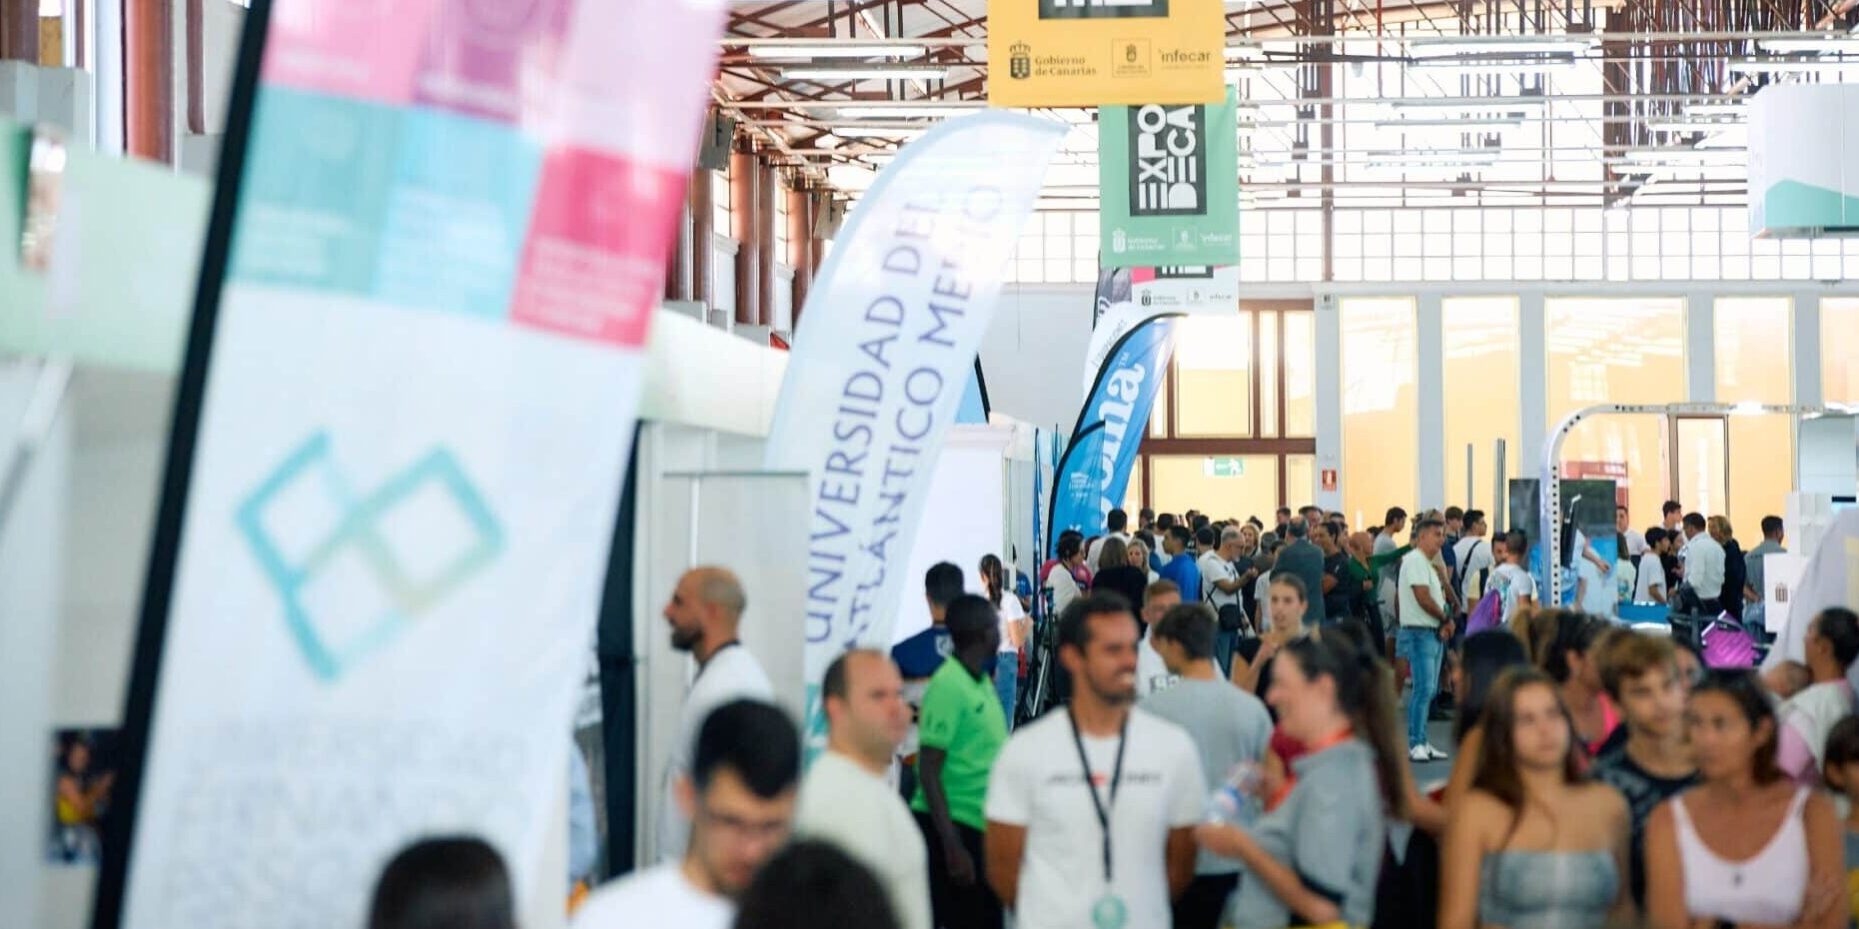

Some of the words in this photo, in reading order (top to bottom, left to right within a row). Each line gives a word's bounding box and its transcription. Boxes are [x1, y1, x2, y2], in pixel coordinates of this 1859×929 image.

[1035, 55, 1086, 66] Gobierno
[1035, 67, 1047, 77] de
[1050, 67, 1097, 77] Canarias
[1158, 49, 1211, 63] infecar
[1138, 104, 1168, 209] EXPO
[1167, 105, 1197, 209] DECA
[805, 295, 905, 643] UNIVERSIDAD
